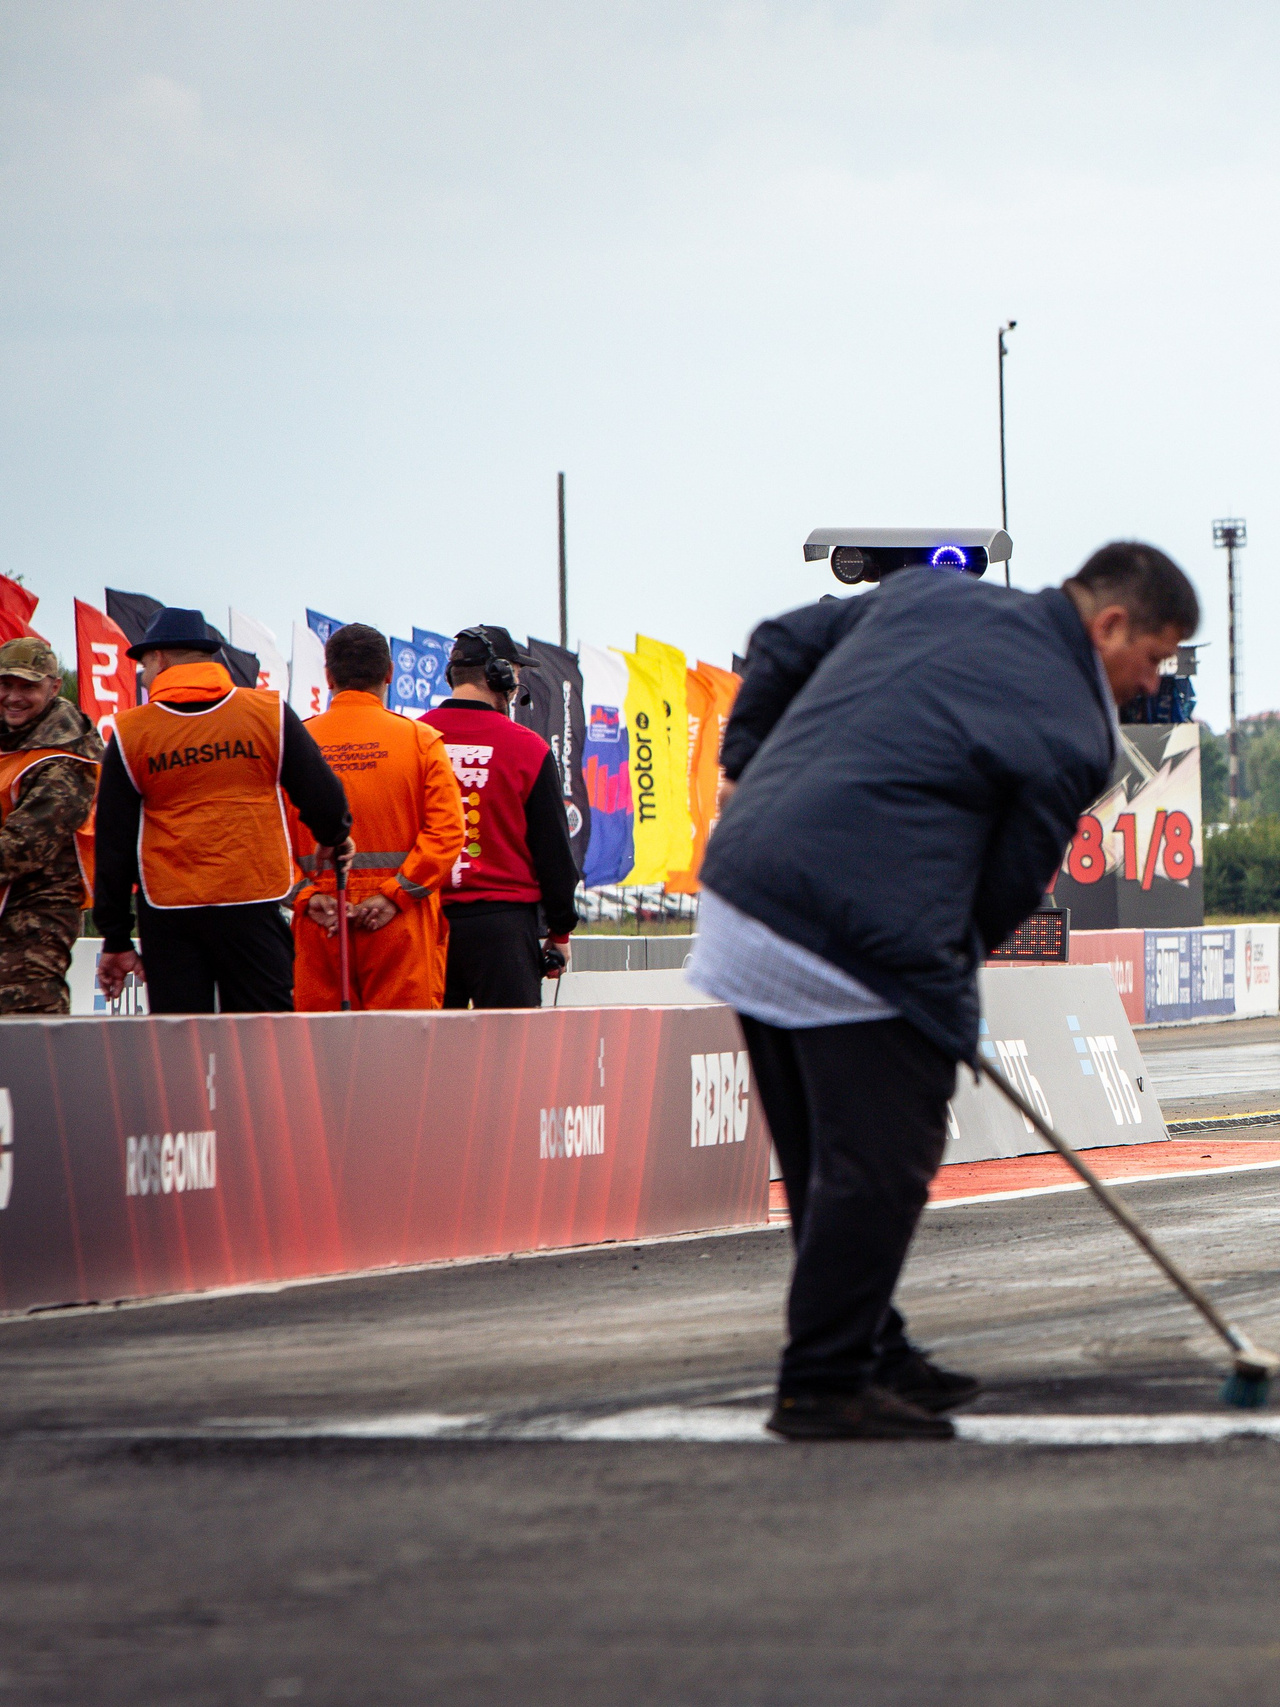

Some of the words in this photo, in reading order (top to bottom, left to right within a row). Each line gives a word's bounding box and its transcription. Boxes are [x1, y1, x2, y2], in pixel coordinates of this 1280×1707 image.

[148, 740, 261, 774] MARSHAL
[323, 751, 388, 762] мобильная
[332, 761, 378, 773] ерация
[634, 733, 656, 823] motor
[1113, 810, 1195, 891] 1/8
[691, 1050, 749, 1148] RDRC
[540, 1104, 605, 1159] ROSGONKI
[125, 1130, 217, 1196] ROSGONKI
